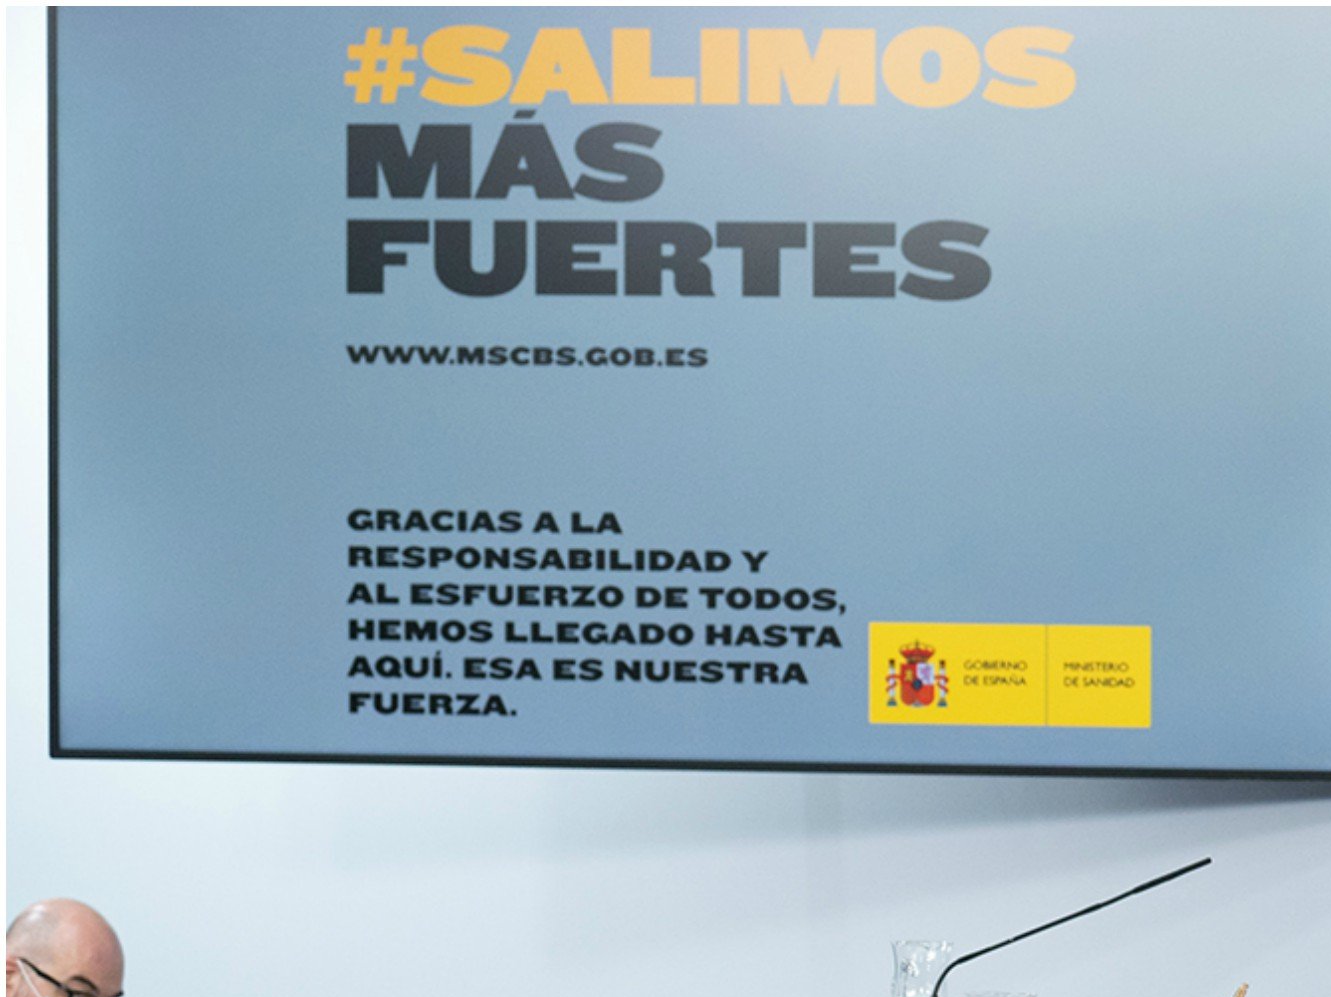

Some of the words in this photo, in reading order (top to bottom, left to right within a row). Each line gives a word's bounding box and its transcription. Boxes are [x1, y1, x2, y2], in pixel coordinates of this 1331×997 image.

[343, 24, 1077, 109] #SALIMOS
[345, 109, 664, 203] MÁS
[345, 217, 992, 301] FUERTES
[345, 344, 708, 368] WWW.MSCBS.GOB.ES
[347, 508, 523, 534] GRACIAS
[532, 511, 560, 534] A
[570, 511, 623, 535] LA
[348, 545, 732, 573] RESPONSABILIDAD
[741, 550, 769, 574] Y
[347, 582, 400, 605] AL
[409, 582, 625, 609] ESFUERZO
[635, 586, 689, 609] DE
[698, 586, 846, 615] TODOS,
[348, 618, 494, 644] HEMOS
[504, 621, 695, 647] LLEGADO
[705, 623, 842, 648] HASTA
[347, 650, 452, 679] AQUÍ.
[463, 657, 542, 681] ESA
[552, 658, 604, 682] ES
[614, 659, 809, 685] NUESTRA
[963, 660, 1028, 671] GOBIERNO
[963, 675, 979, 686] DE
[982, 672, 1027, 686] ESPAÑA
[1063, 661, 1129, 673] MINISTERIO
[1063, 676, 1079, 688] DE
[1082, 677, 1135, 688] SANIDAD
[348, 691, 517, 717] FUERZA.
